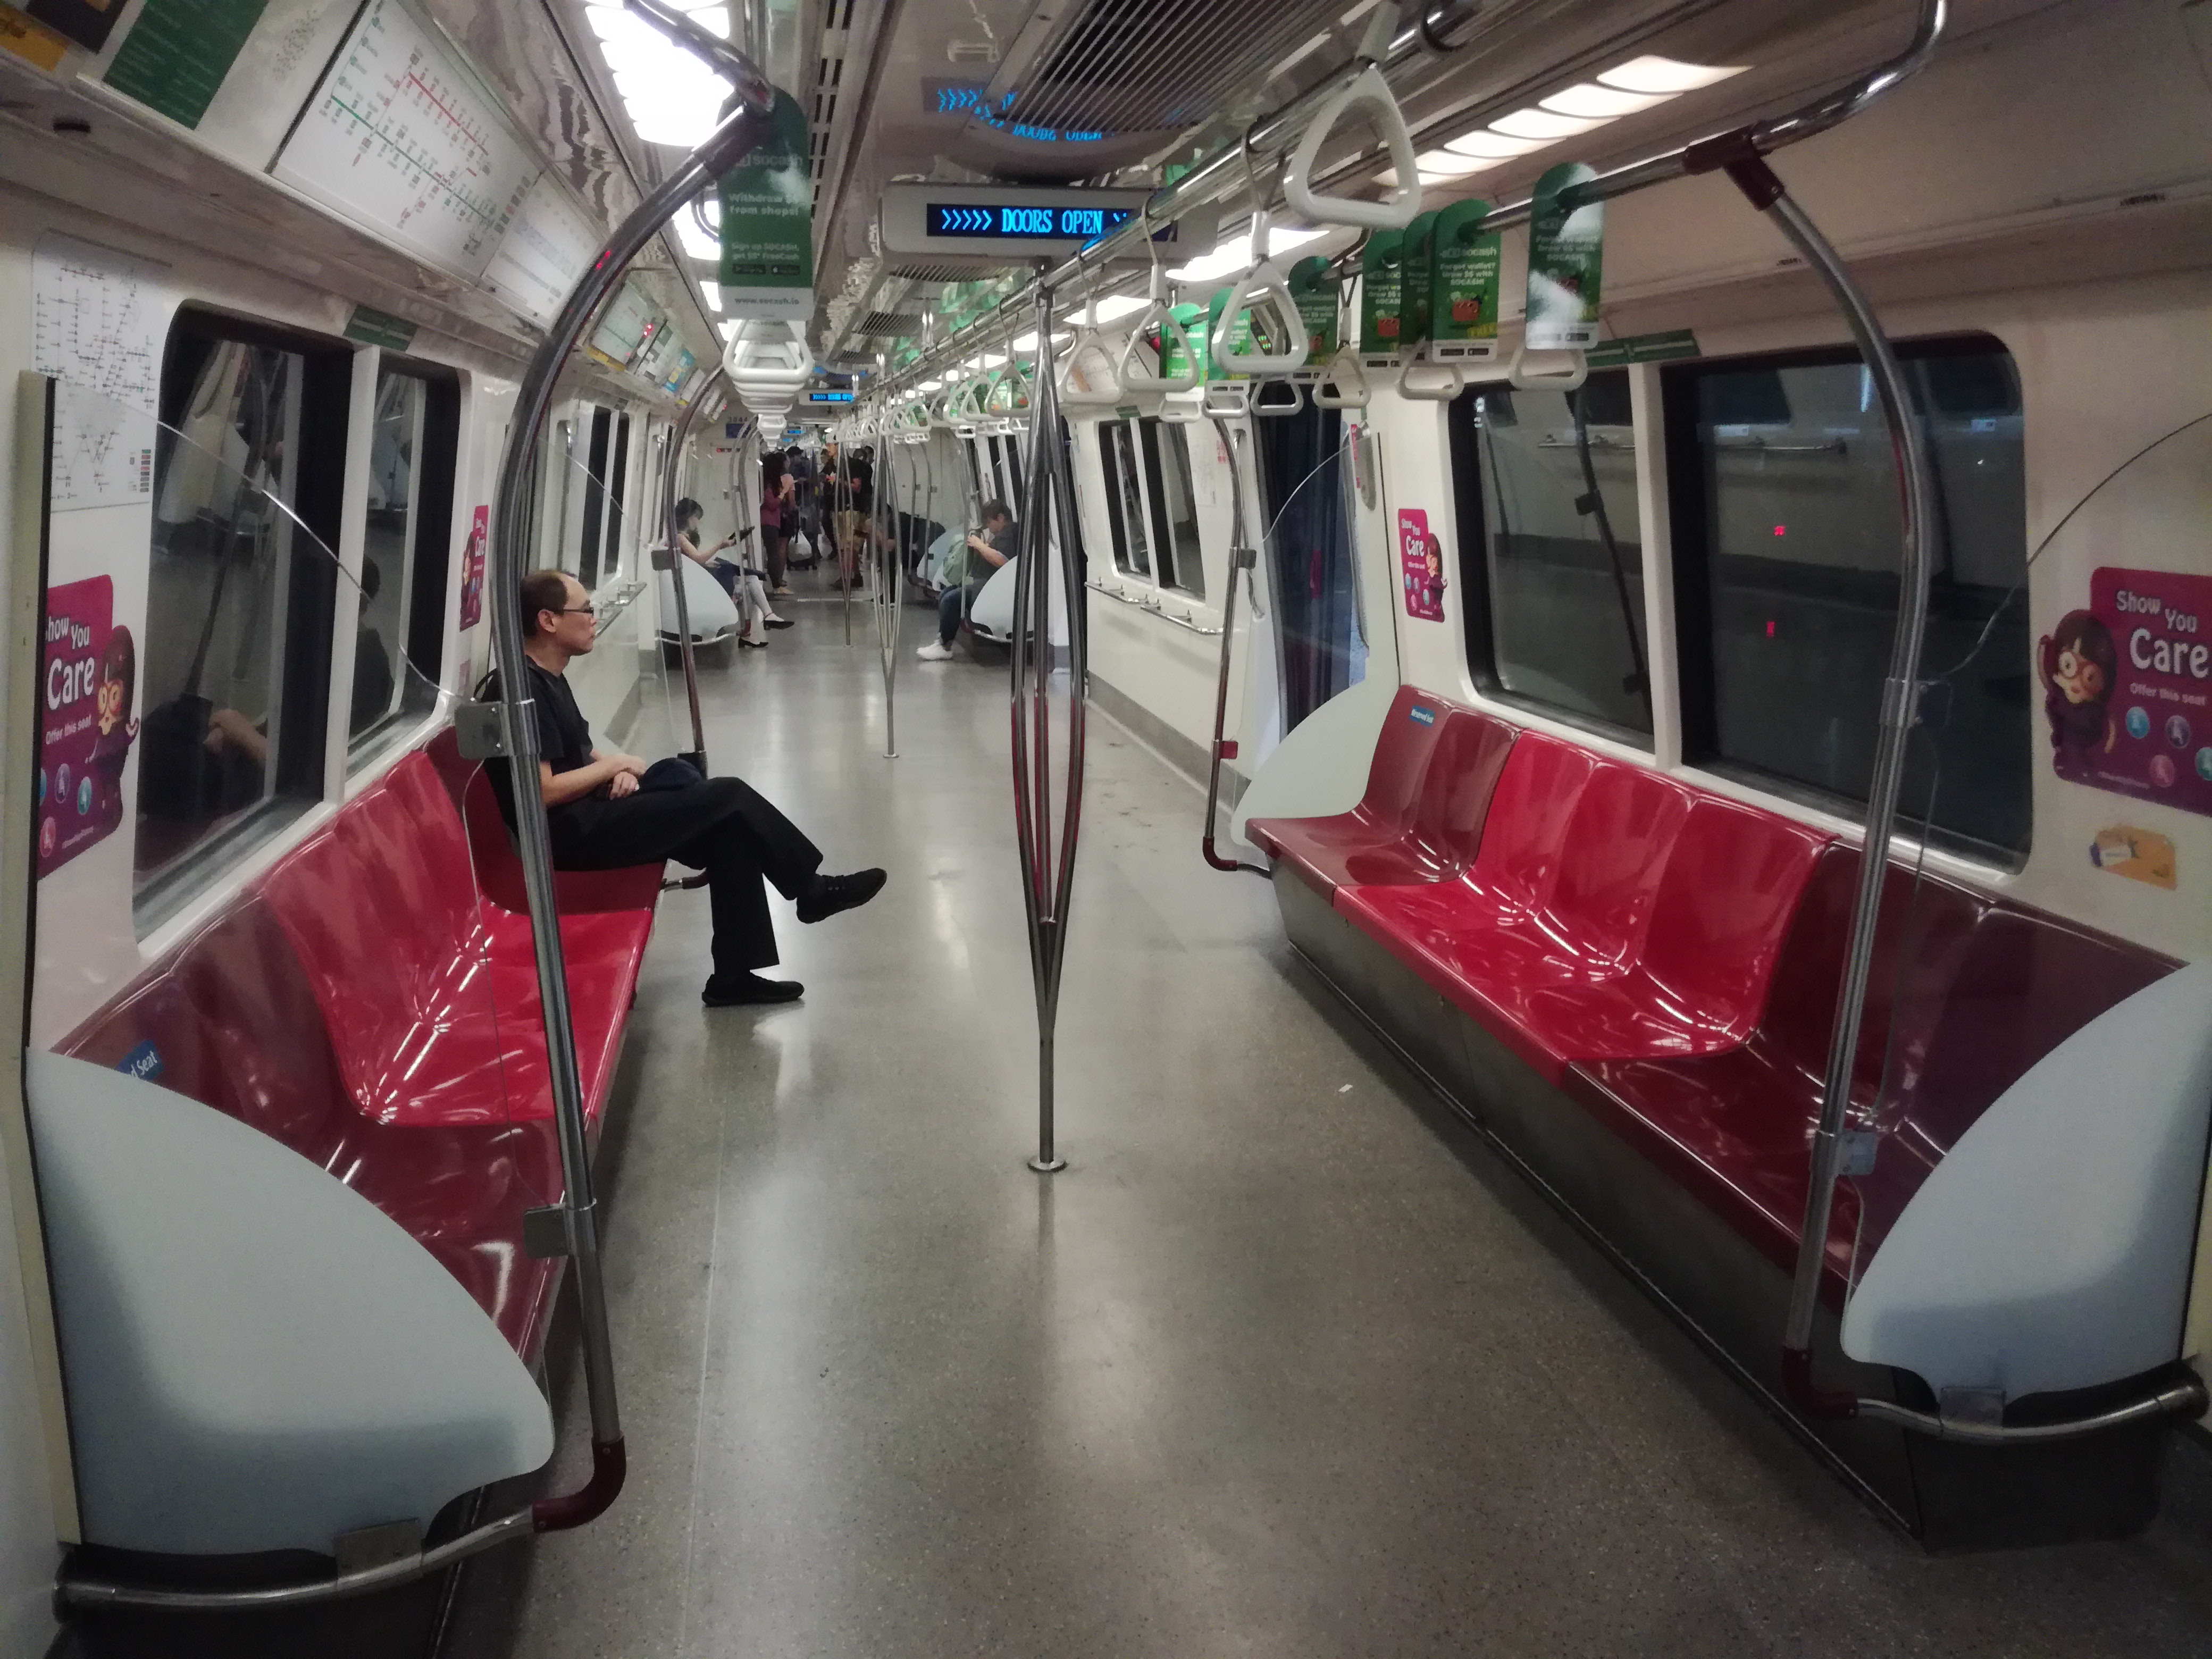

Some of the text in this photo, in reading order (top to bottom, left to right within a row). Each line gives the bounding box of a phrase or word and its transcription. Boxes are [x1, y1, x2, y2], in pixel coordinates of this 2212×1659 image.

[730, 206, 758, 214] from
[1002, 208, 1103, 234] DOORS OPEN
[1406, 535, 1425, 557] Care
[2116, 590, 2161, 615] Show
[46, 615, 69, 642] how
[2165, 608, 2198, 633] You
[71, 624, 90, 650] You
[2130, 628, 2209, 678] Care
[47, 657, 95, 710] Care
[46, 728, 63, 745] Offer
[137, 1050, 158, 1076] Seat
